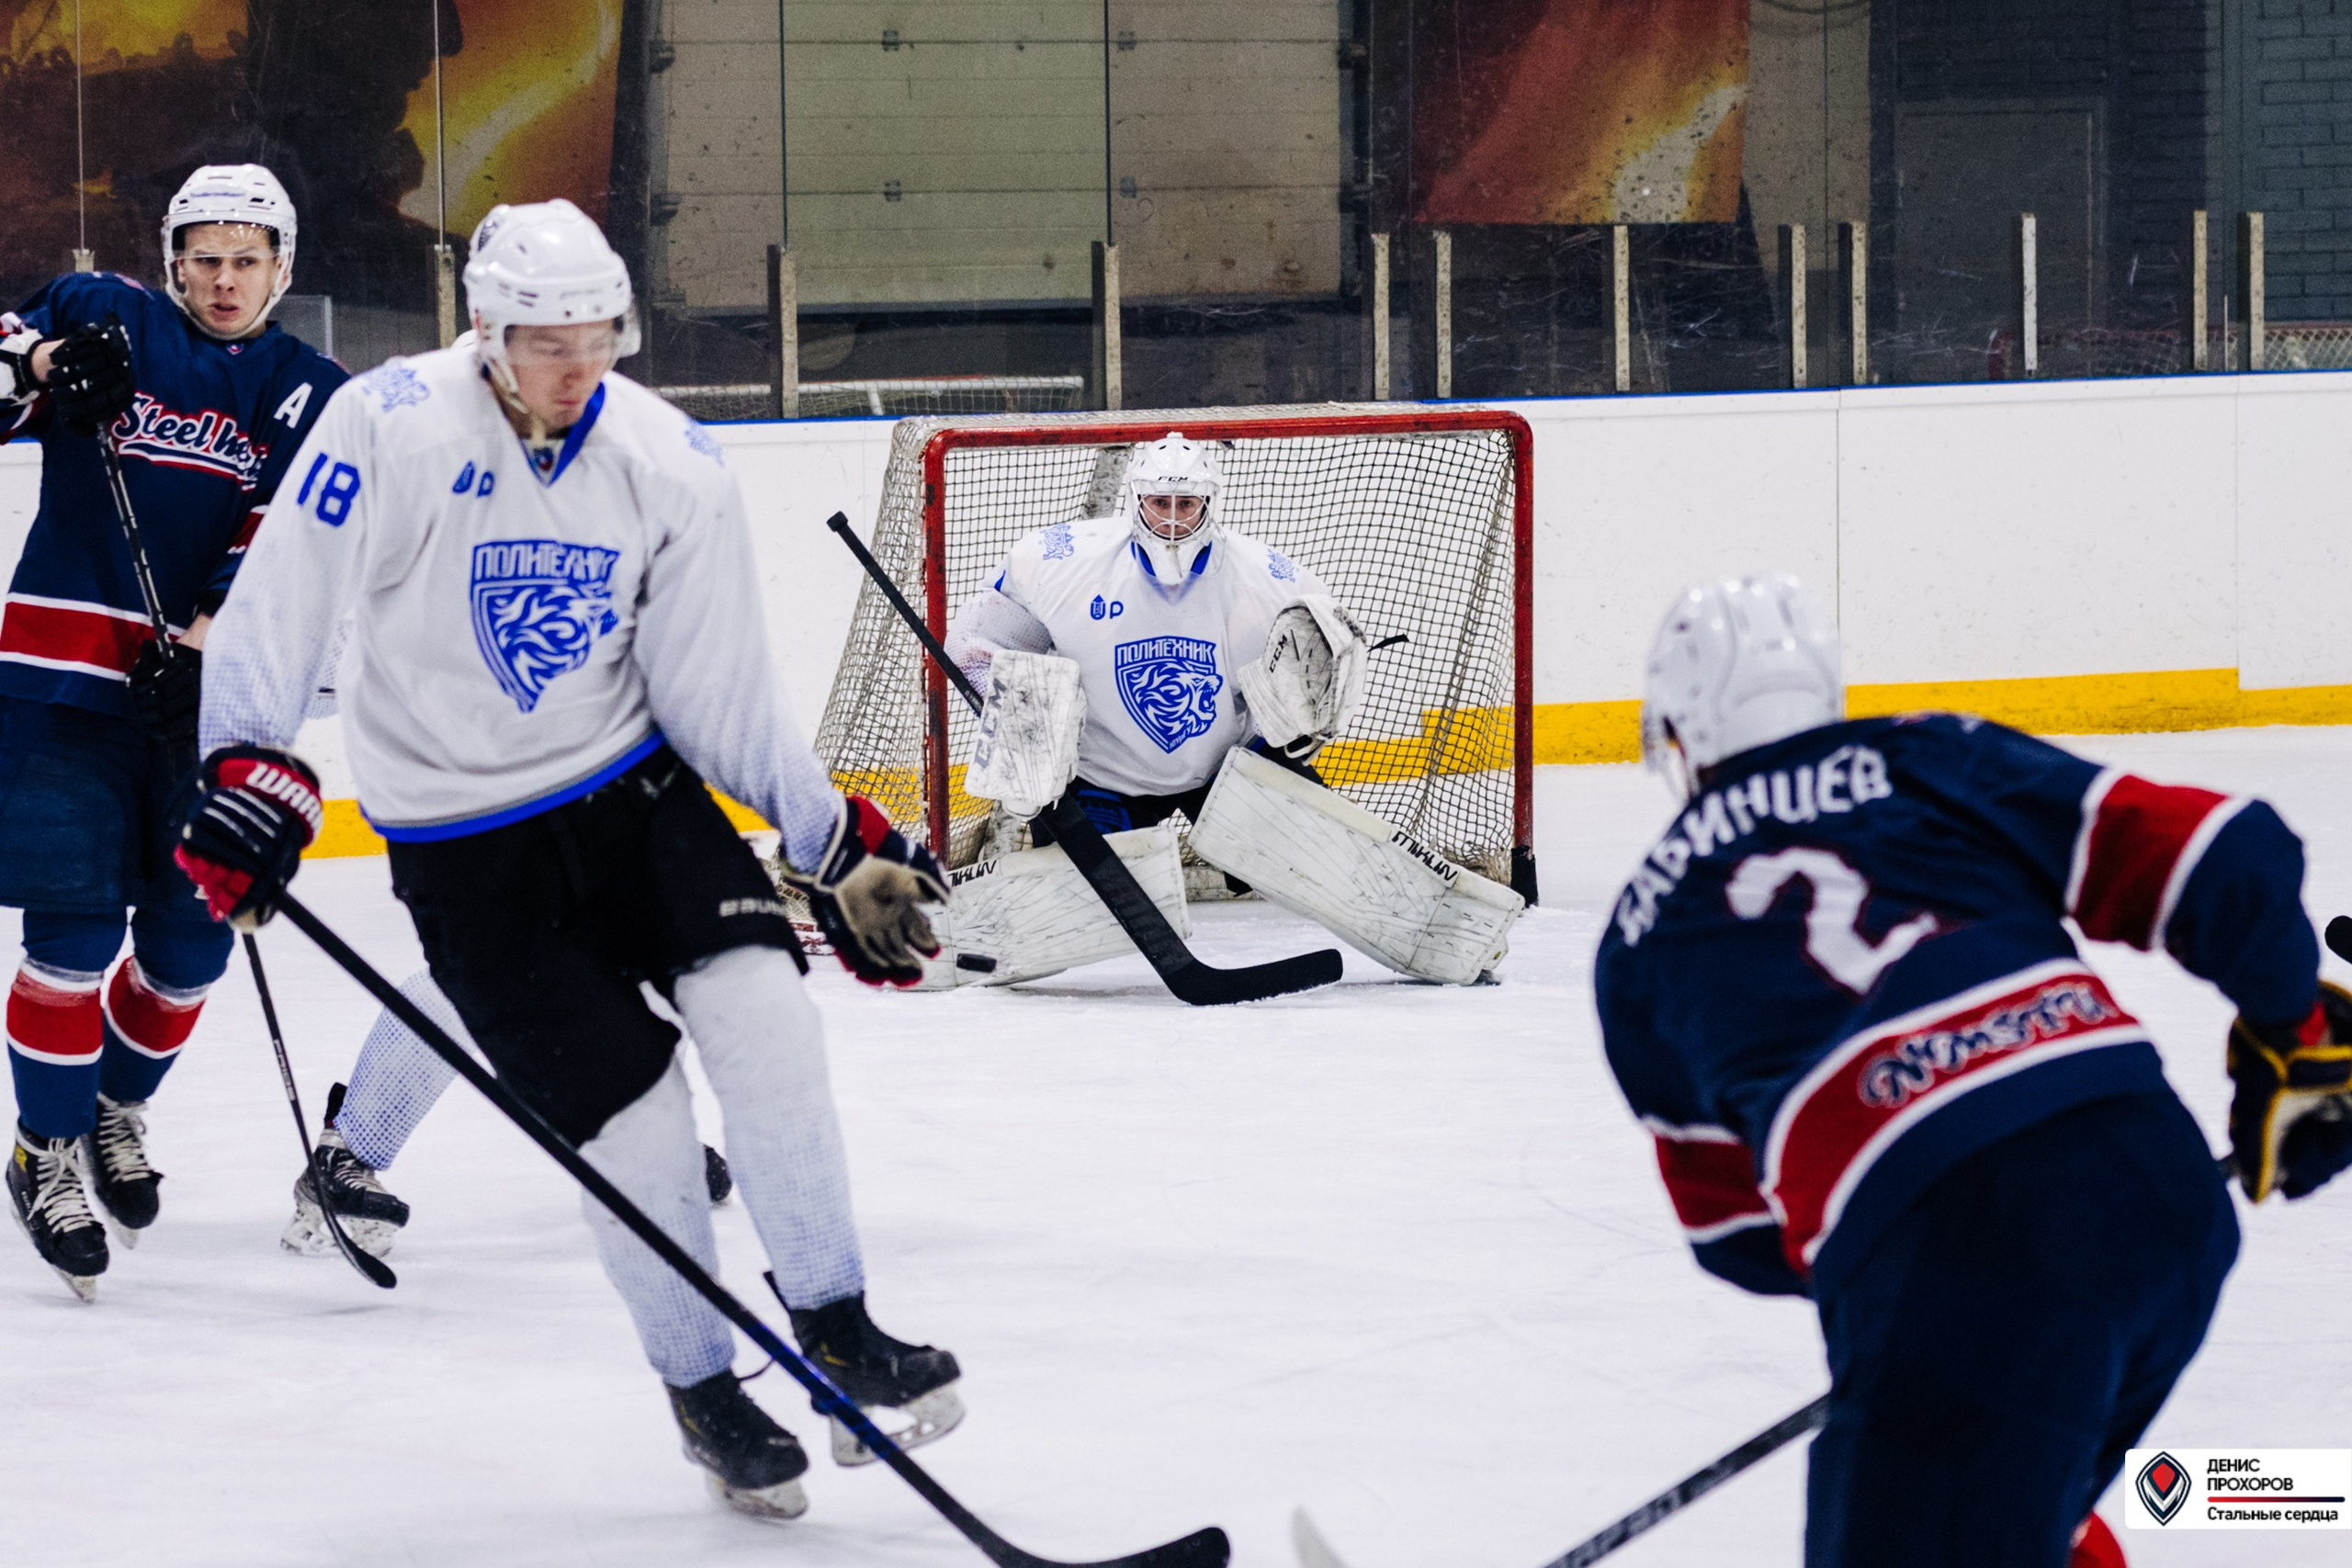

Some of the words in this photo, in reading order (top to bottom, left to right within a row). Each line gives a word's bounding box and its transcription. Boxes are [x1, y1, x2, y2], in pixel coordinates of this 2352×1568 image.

[111, 392, 218, 451] Steel
[274, 382, 322, 429] A
[297, 452, 361, 528] 18
[1116, 638, 1213, 667] ПОЛИТЕХНИК
[1269, 634, 1288, 673] CCM
[974, 678, 1008, 769] CCM
[1724, 845, 1938, 996] 2
